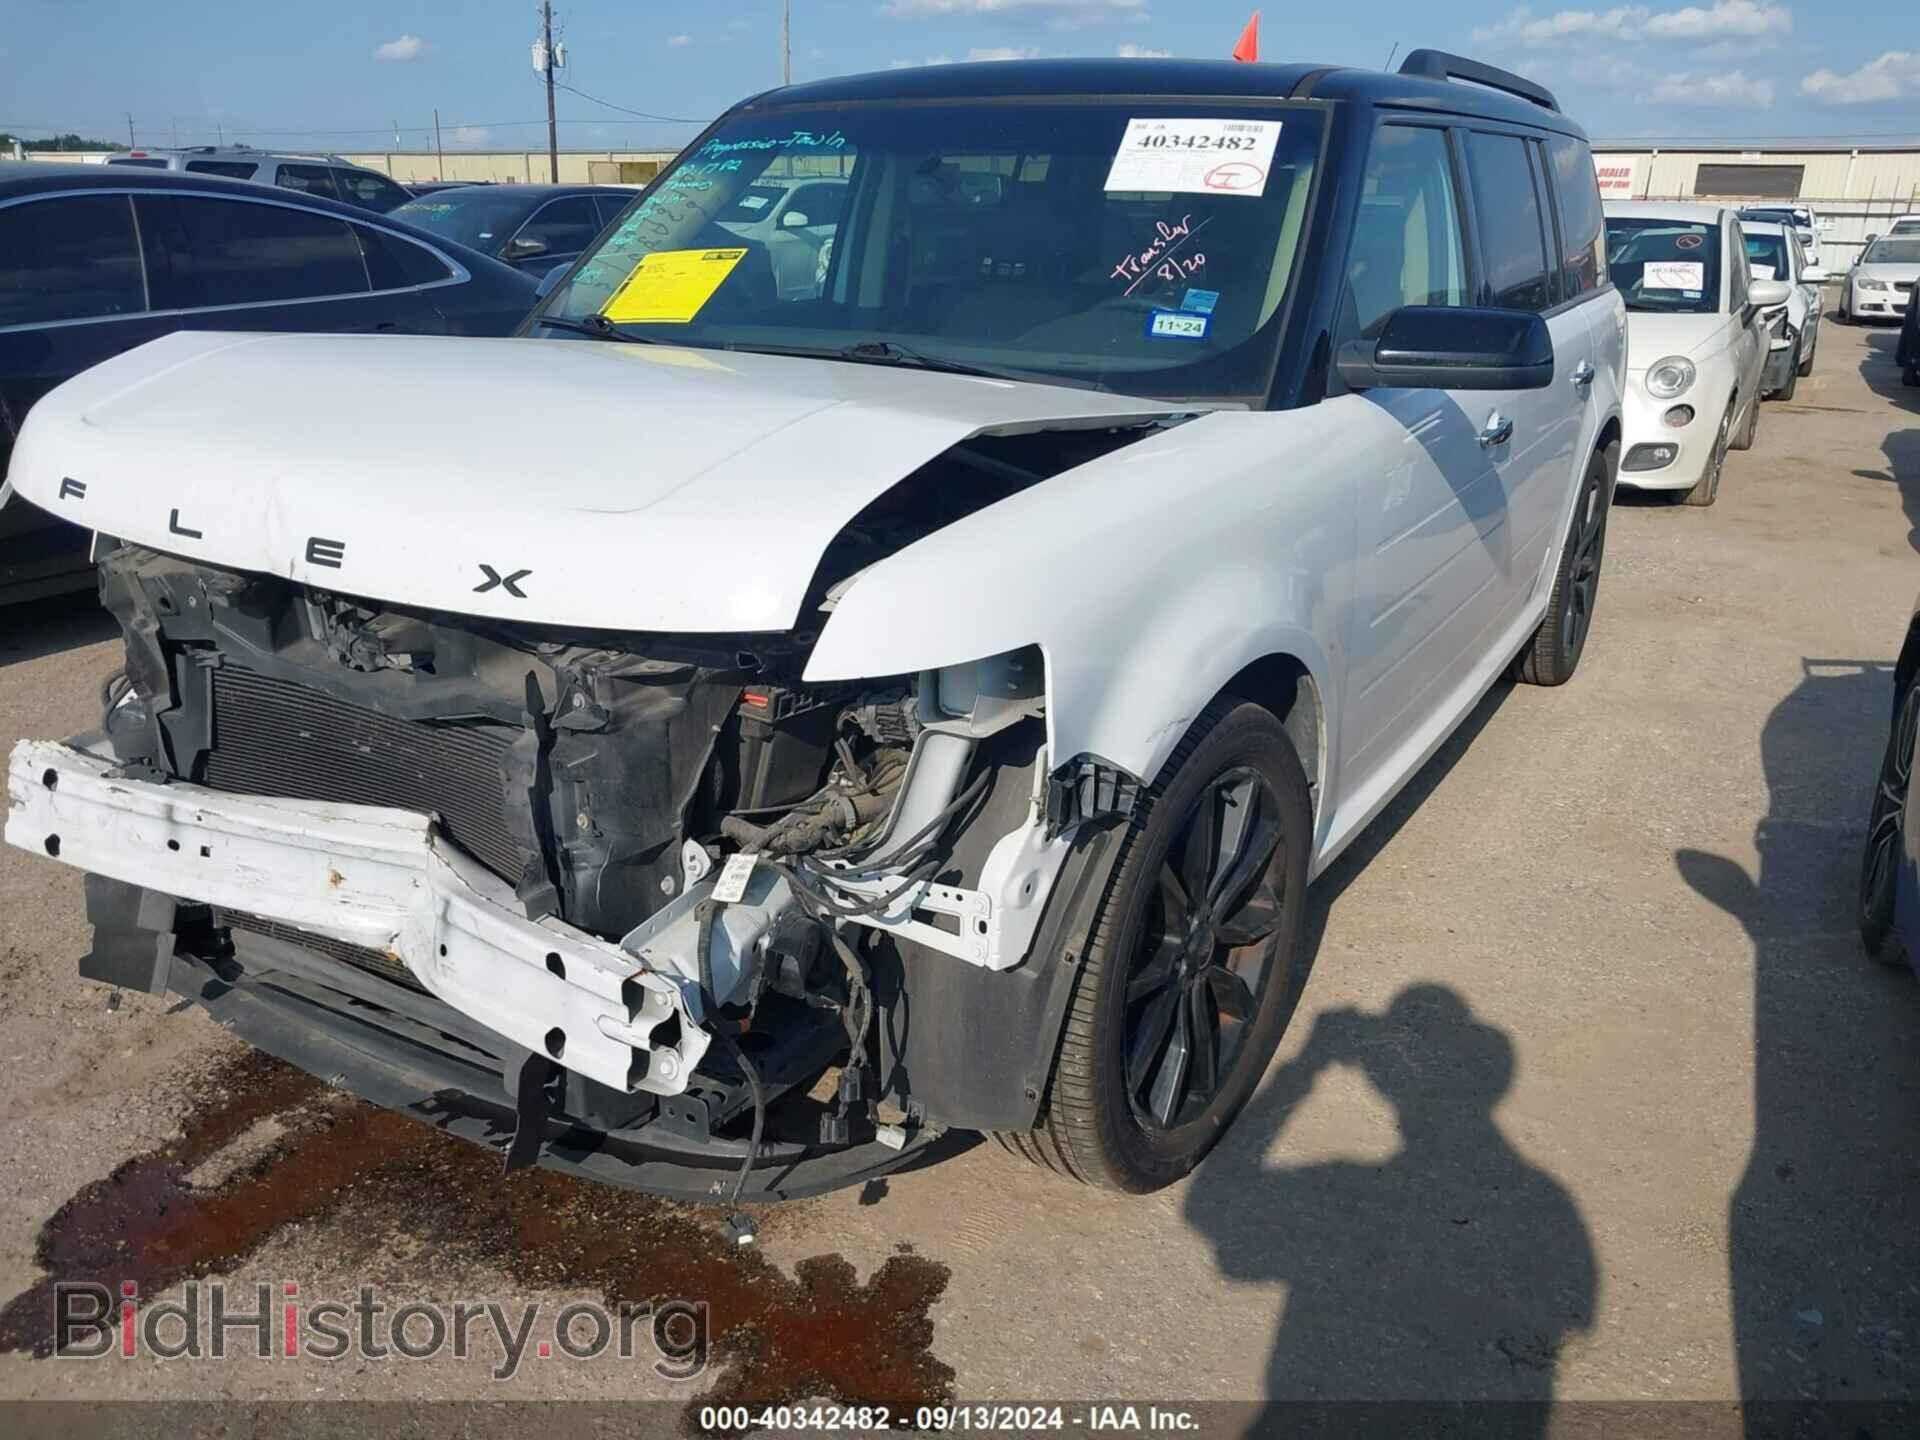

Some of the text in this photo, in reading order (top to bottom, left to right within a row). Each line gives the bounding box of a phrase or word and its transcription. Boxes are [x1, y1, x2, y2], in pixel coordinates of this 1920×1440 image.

[1137, 134, 1257, 151] 40342482
[1157, 252, 1206, 281] 8/20
[58, 476, 533, 599] FLEX
